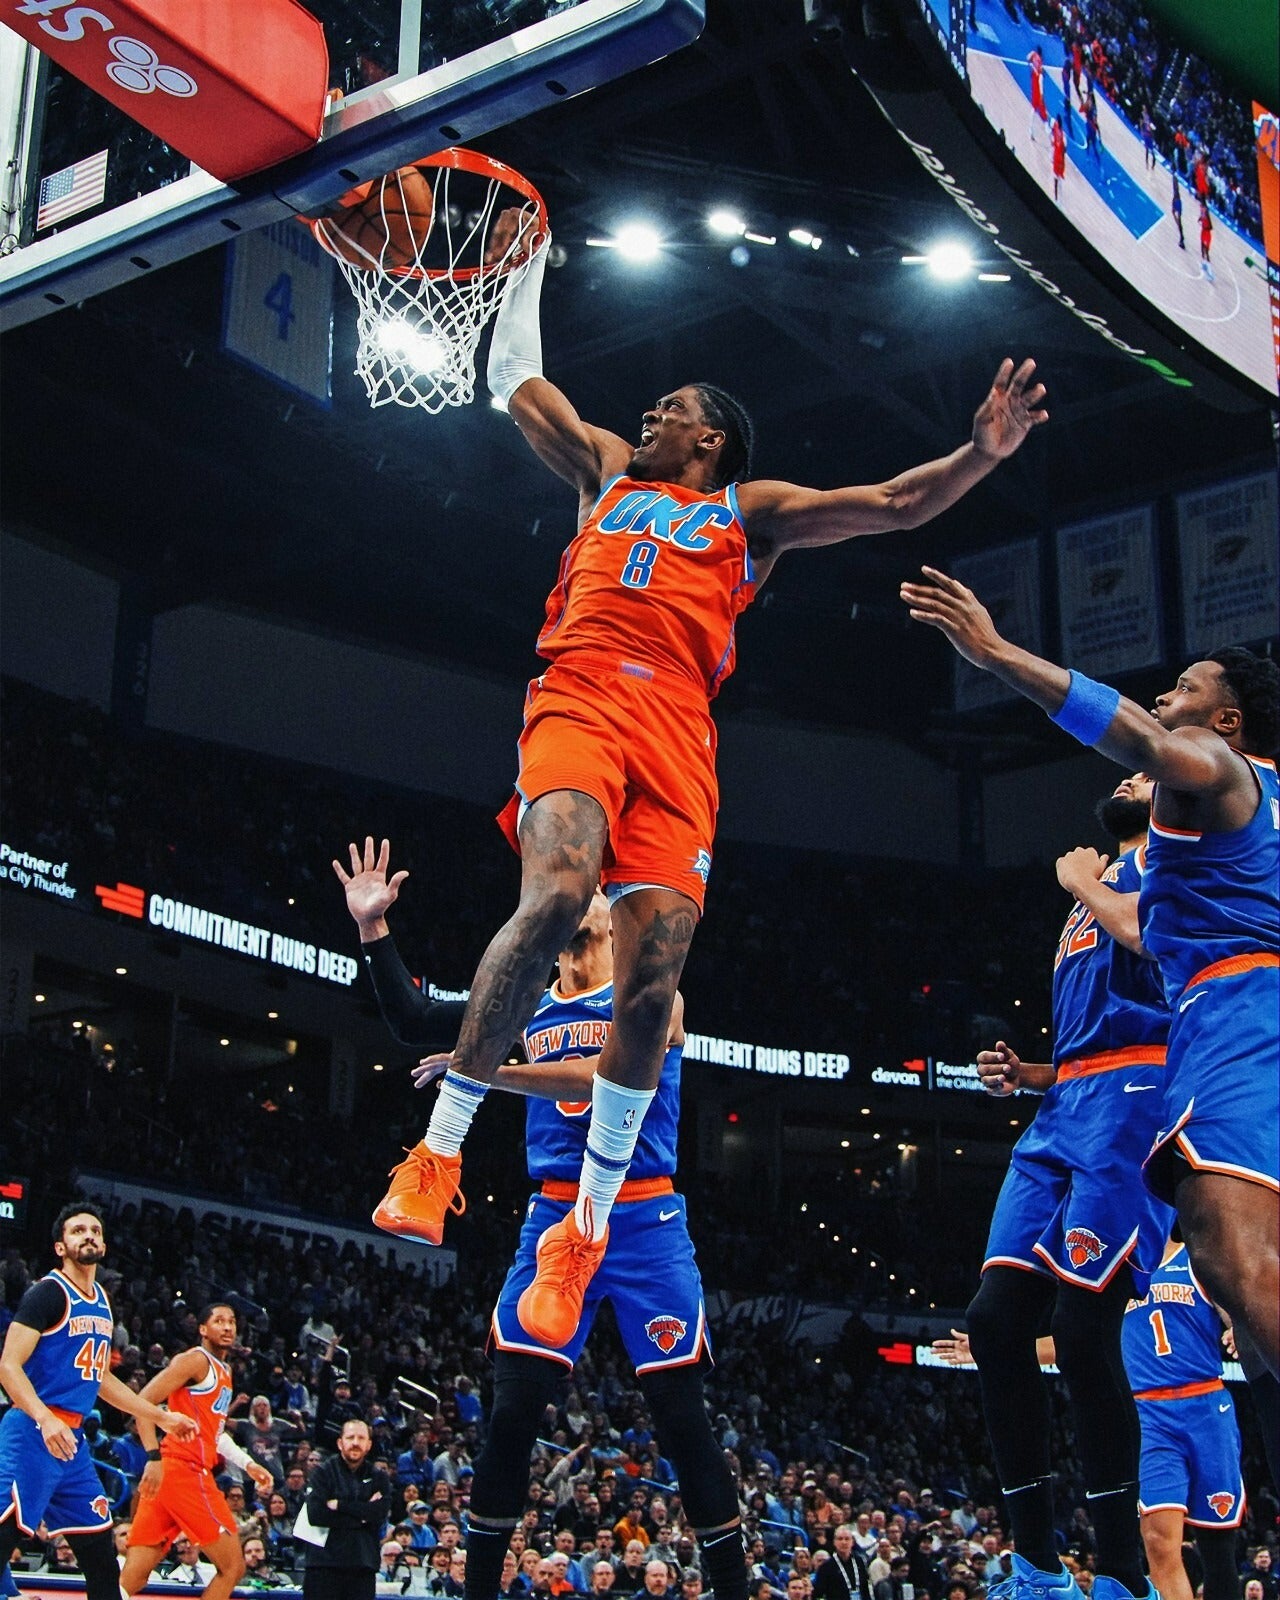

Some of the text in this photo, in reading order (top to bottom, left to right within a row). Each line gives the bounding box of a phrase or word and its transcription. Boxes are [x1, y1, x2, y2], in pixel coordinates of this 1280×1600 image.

[264, 272, 294, 341] 4
[597, 491, 735, 551] OKC
[620, 540, 659, 589] 8
[0, 843, 52, 875] Partner
[52, 862, 69, 879] of
[9, 866, 32, 888] City
[33, 873, 77, 899] Thunder
[149, 894, 358, 986] COMMITMENT RUNS DEEP
[528, 1026, 566, 1059] NEW
[755, 1046, 801, 1076] RUNS
[803, 1051, 850, 1080] DEEP
[871, 1067, 920, 1086] devon
[936, 1077, 952, 1089] the
[1150, 1283, 1196, 1307] YORK
[1149, 1309, 1173, 1357] 1
[74, 1337, 109, 1382] 44
